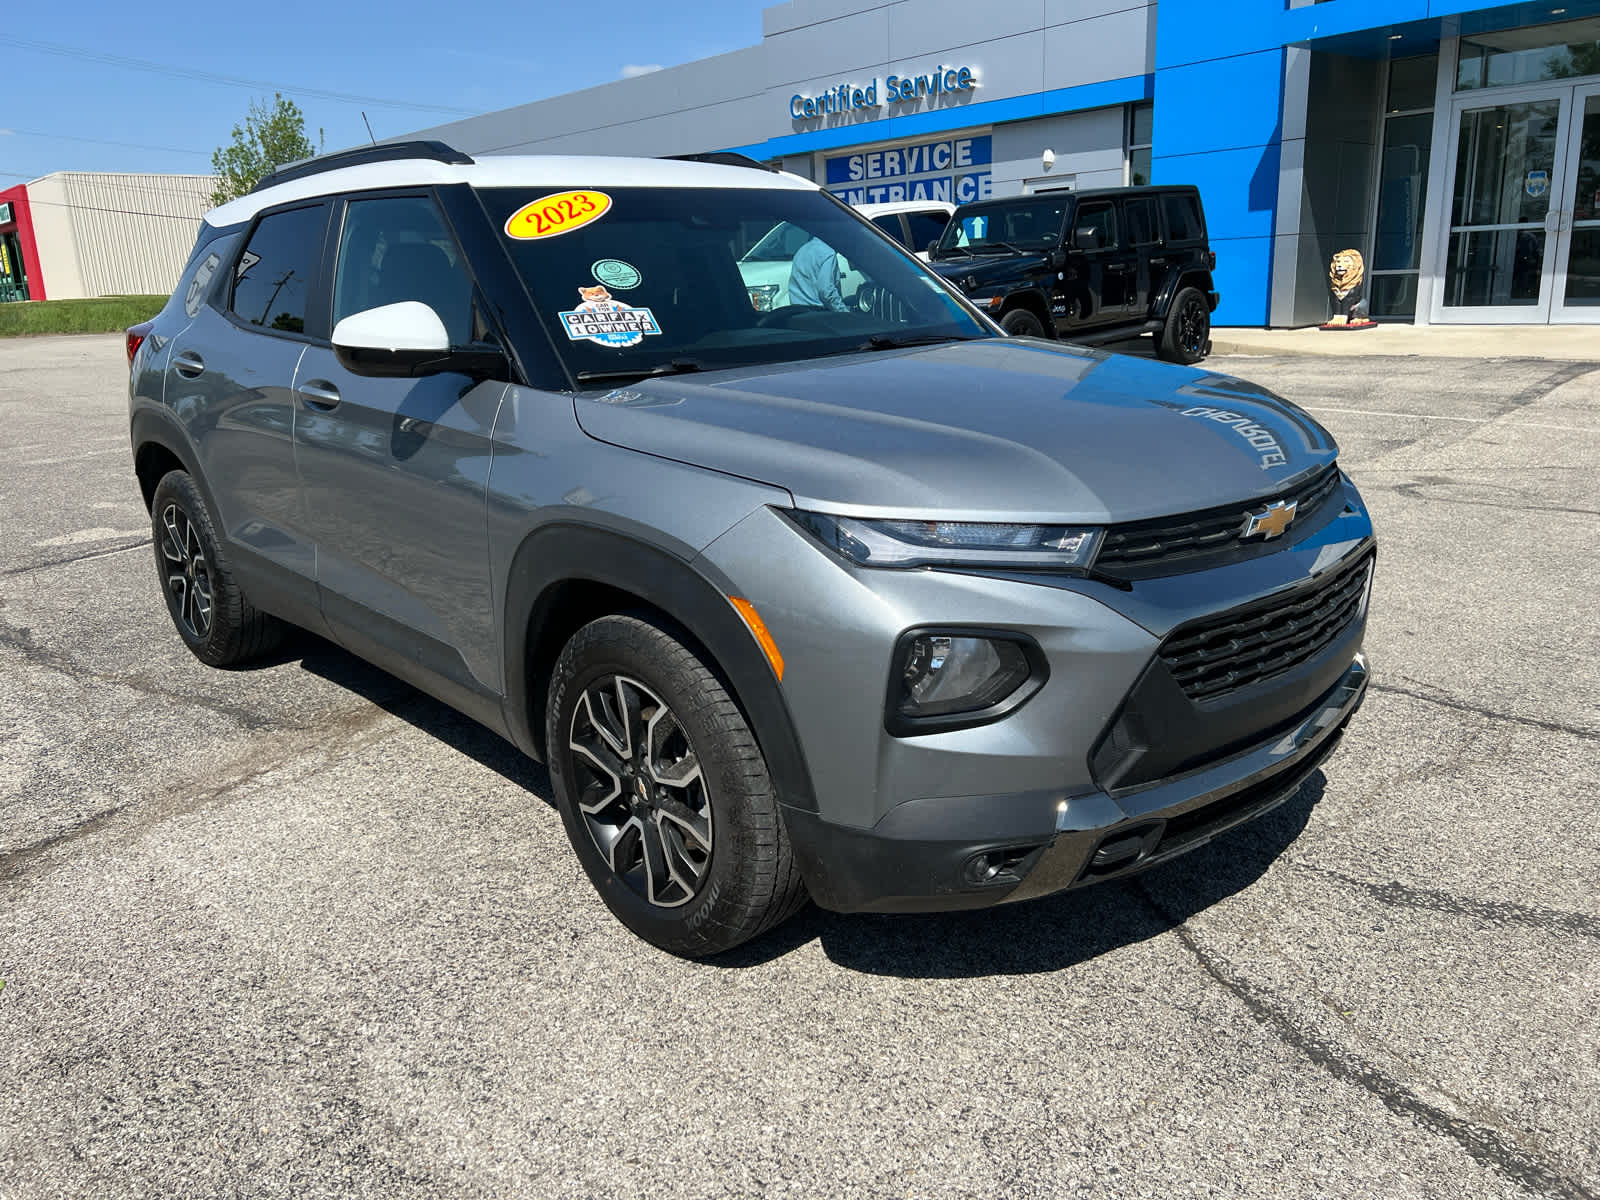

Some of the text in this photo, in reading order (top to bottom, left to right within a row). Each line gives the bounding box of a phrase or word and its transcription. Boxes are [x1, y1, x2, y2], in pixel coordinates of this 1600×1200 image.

[790, 65, 972, 119] Certified Service
[849, 140, 972, 181] SERVICE
[834, 176, 992, 206] NTRANCE
[526, 194, 596, 234] 2023
[567, 311, 651, 324] CARFAX
[586, 322, 653, 334] OWNER
